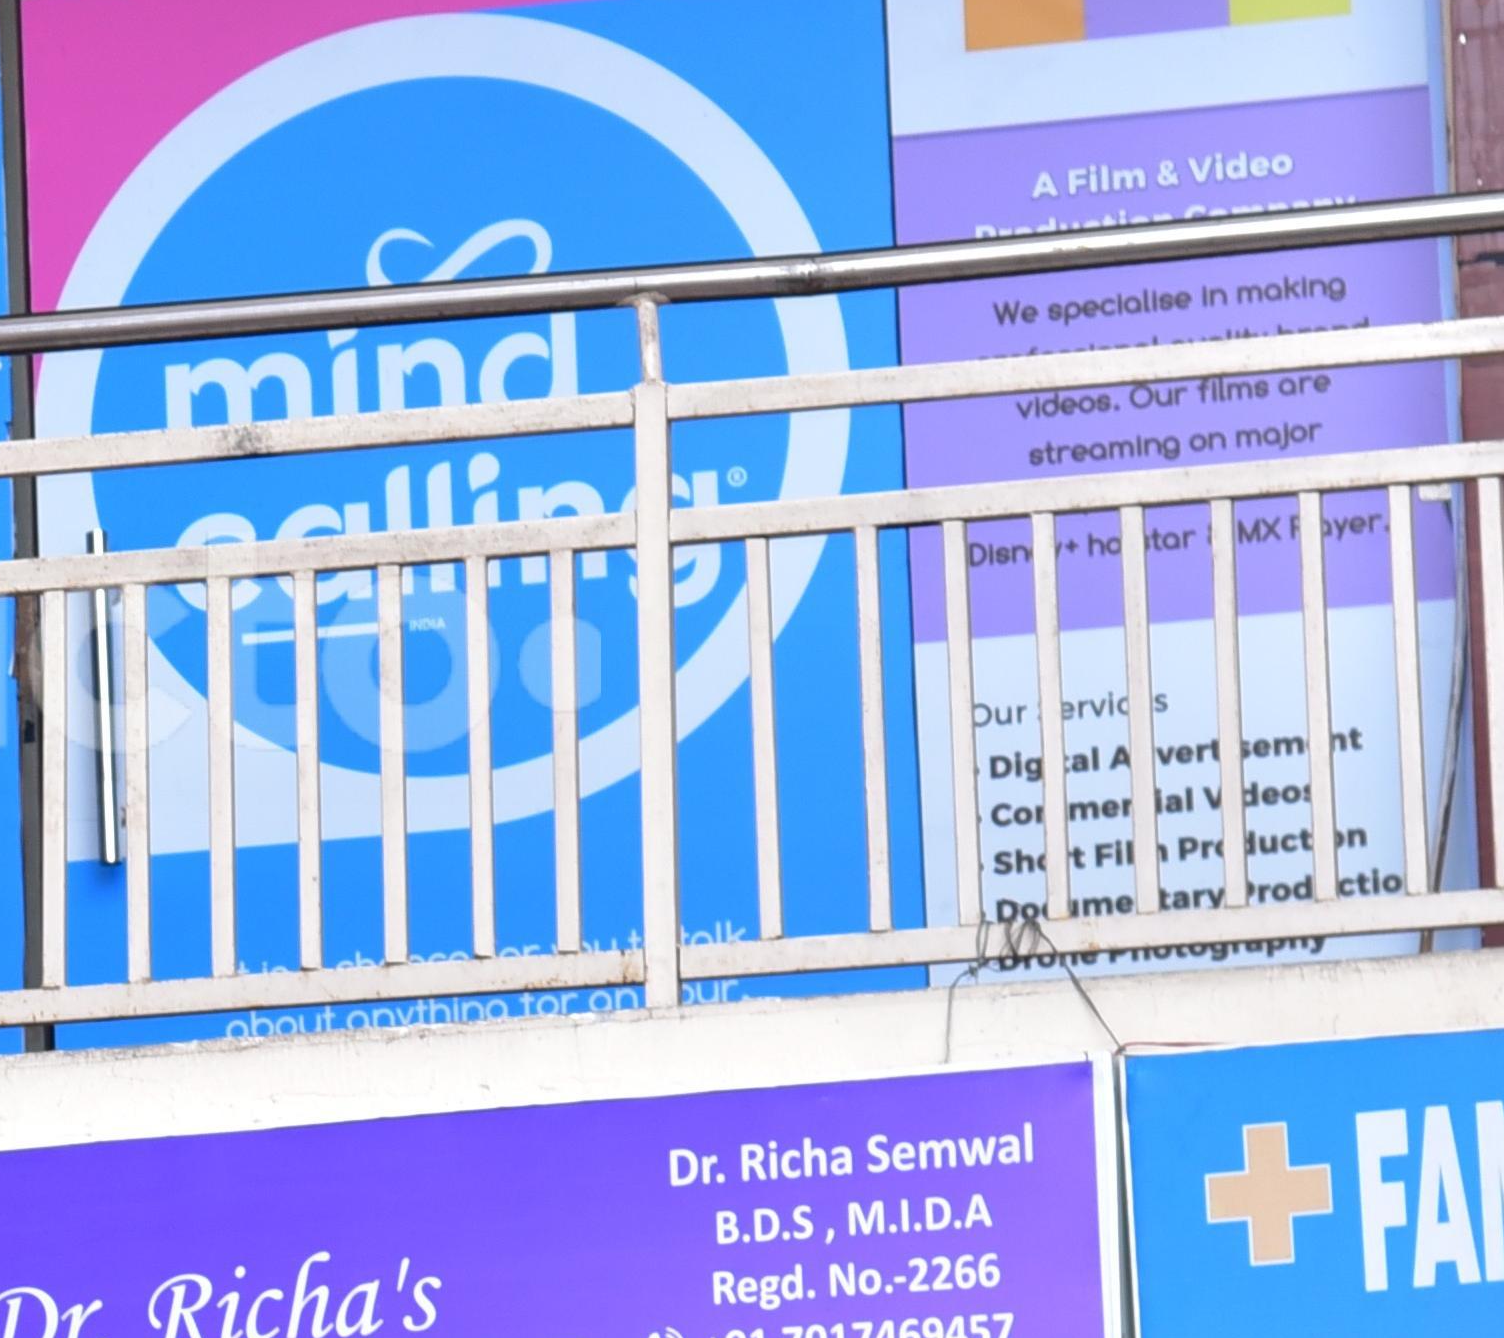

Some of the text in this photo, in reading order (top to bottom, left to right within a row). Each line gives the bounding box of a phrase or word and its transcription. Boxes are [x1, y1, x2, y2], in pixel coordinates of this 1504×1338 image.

[1032, 152, 1292, 198] A Film & Video
[993, 276, 1346, 327] We specialise in making
[165, 312, 579, 429] mind
[1029, 422, 1322, 467] streaming on major
[408, 616, 447, 632] INDIA
[670, 1122, 1033, 1187] Dr. Richa Semwal
[713, 1253, 1000, 1310] Regd. No.-2266
